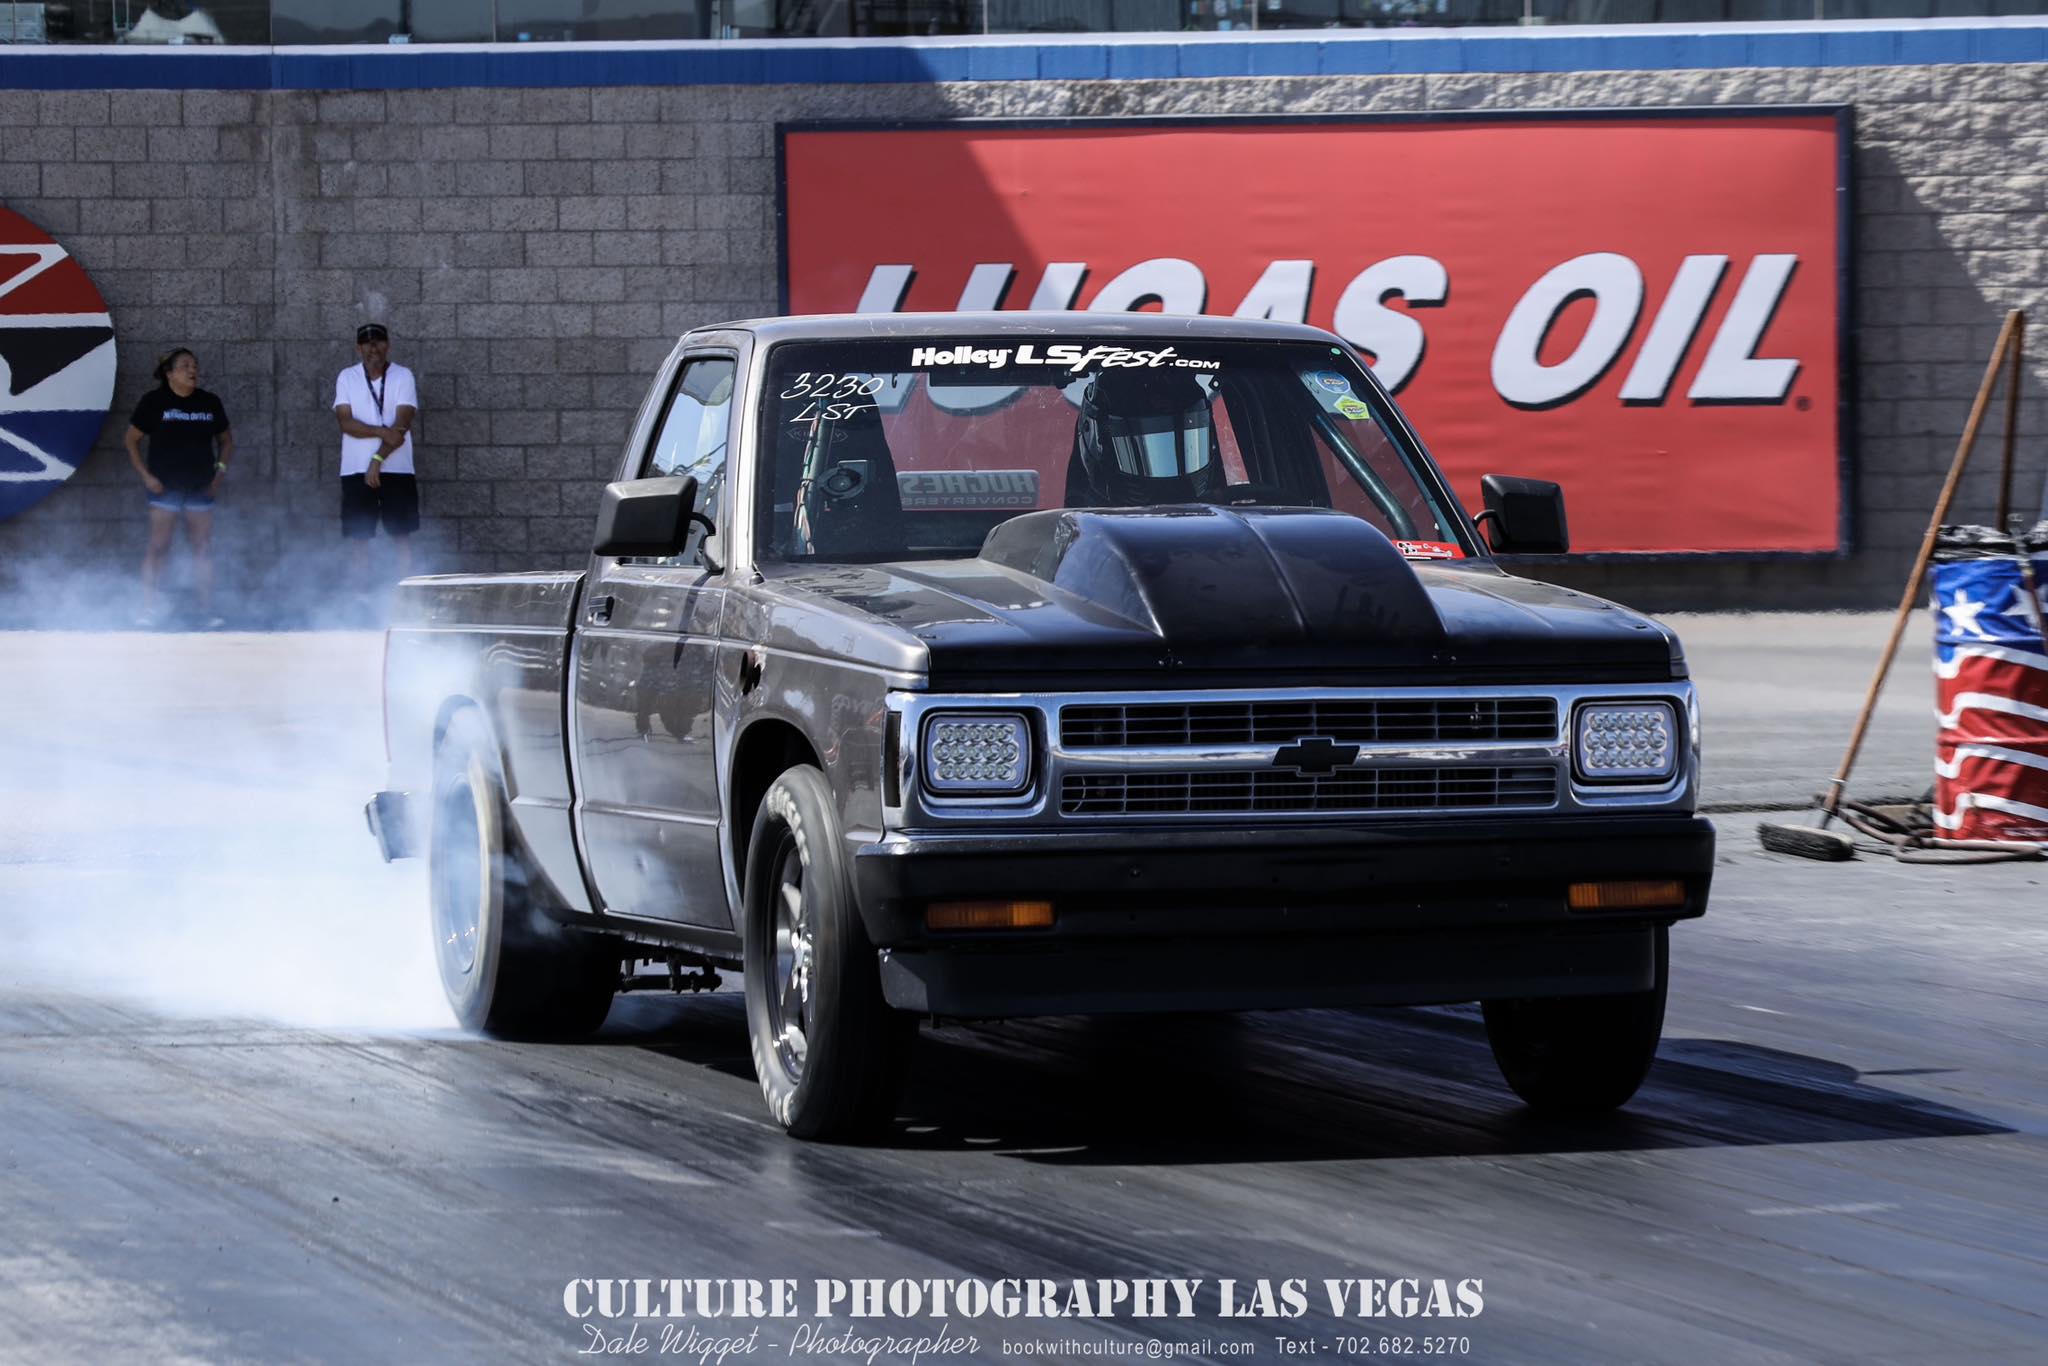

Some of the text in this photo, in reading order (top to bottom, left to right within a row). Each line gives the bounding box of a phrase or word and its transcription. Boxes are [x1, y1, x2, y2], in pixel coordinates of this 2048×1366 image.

[1490, 251, 1802, 406] OIL
[910, 345, 1013, 369] Holley
[780, 372, 885, 399] 3230
[789, 401, 880, 423] LST
